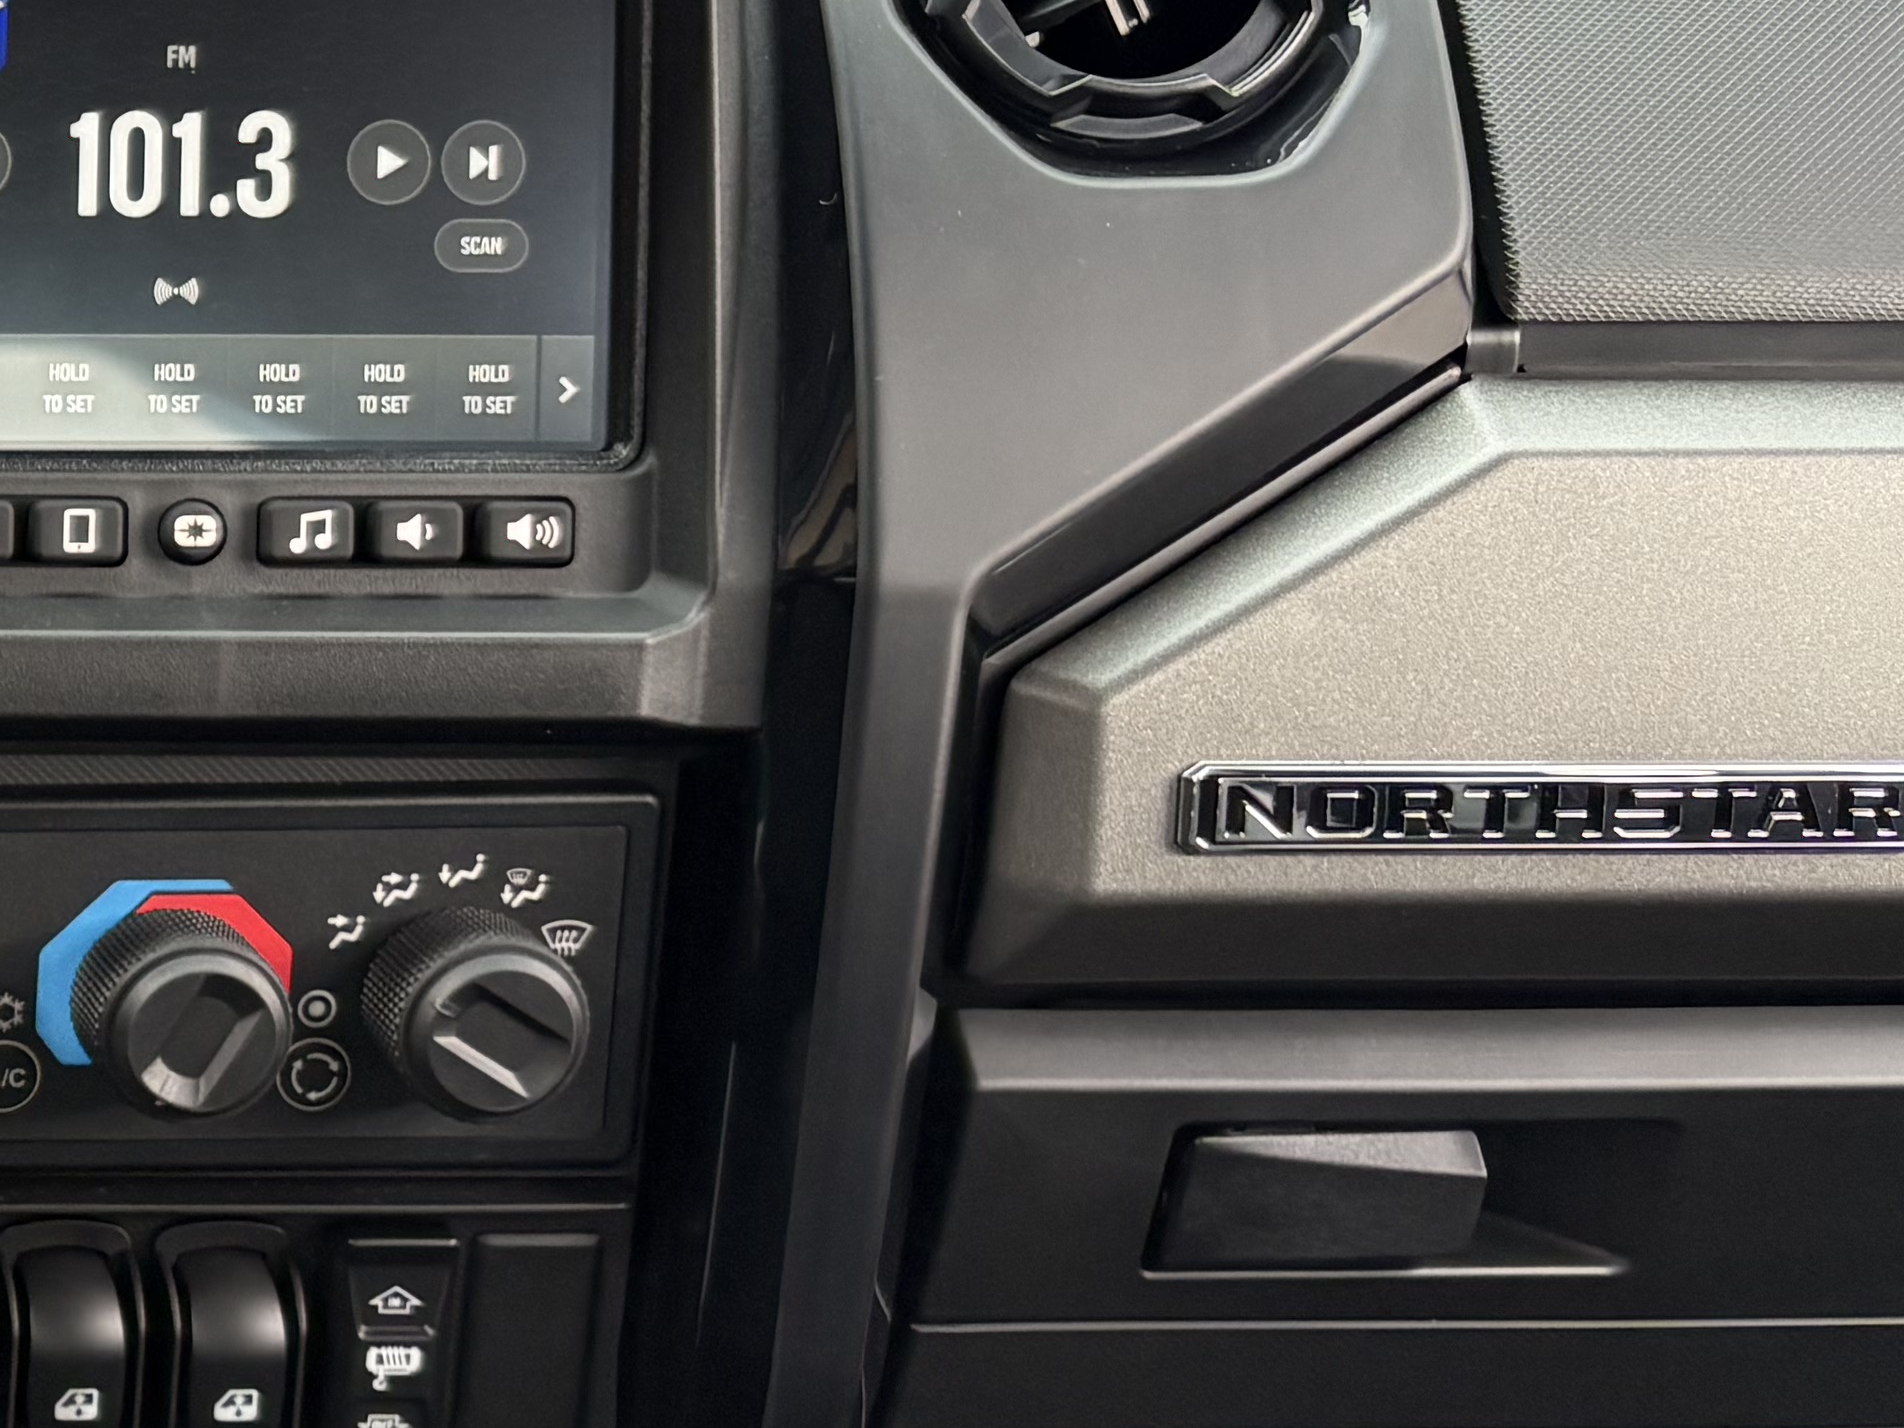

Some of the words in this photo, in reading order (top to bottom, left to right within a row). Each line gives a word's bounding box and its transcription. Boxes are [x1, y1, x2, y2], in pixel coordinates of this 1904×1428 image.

[166, 45, 197, 70] FM
[69, 110, 294, 219] 101.3
[460, 236, 504, 256] SCAN
[49, 363, 89, 383] HOLD
[154, 363, 195, 383] HOLD
[259, 363, 300, 383] HOLD
[364, 363, 405, 383] HOLD
[468, 363, 510, 383] HOLD
[43, 394, 63, 414] TO
[67, 394, 94, 414] SET
[148, 394, 168, 414] TO
[171, 394, 200, 414] SET
[253, 394, 273, 414] TO
[277, 394, 305, 414] SET
[358, 394, 378, 414] TO
[381, 394, 410, 414] SET
[462, 394, 483, 414] TO
[486, 394, 514, 414] SET
[1219, 781, 1903, 840] NORTHSTAR
